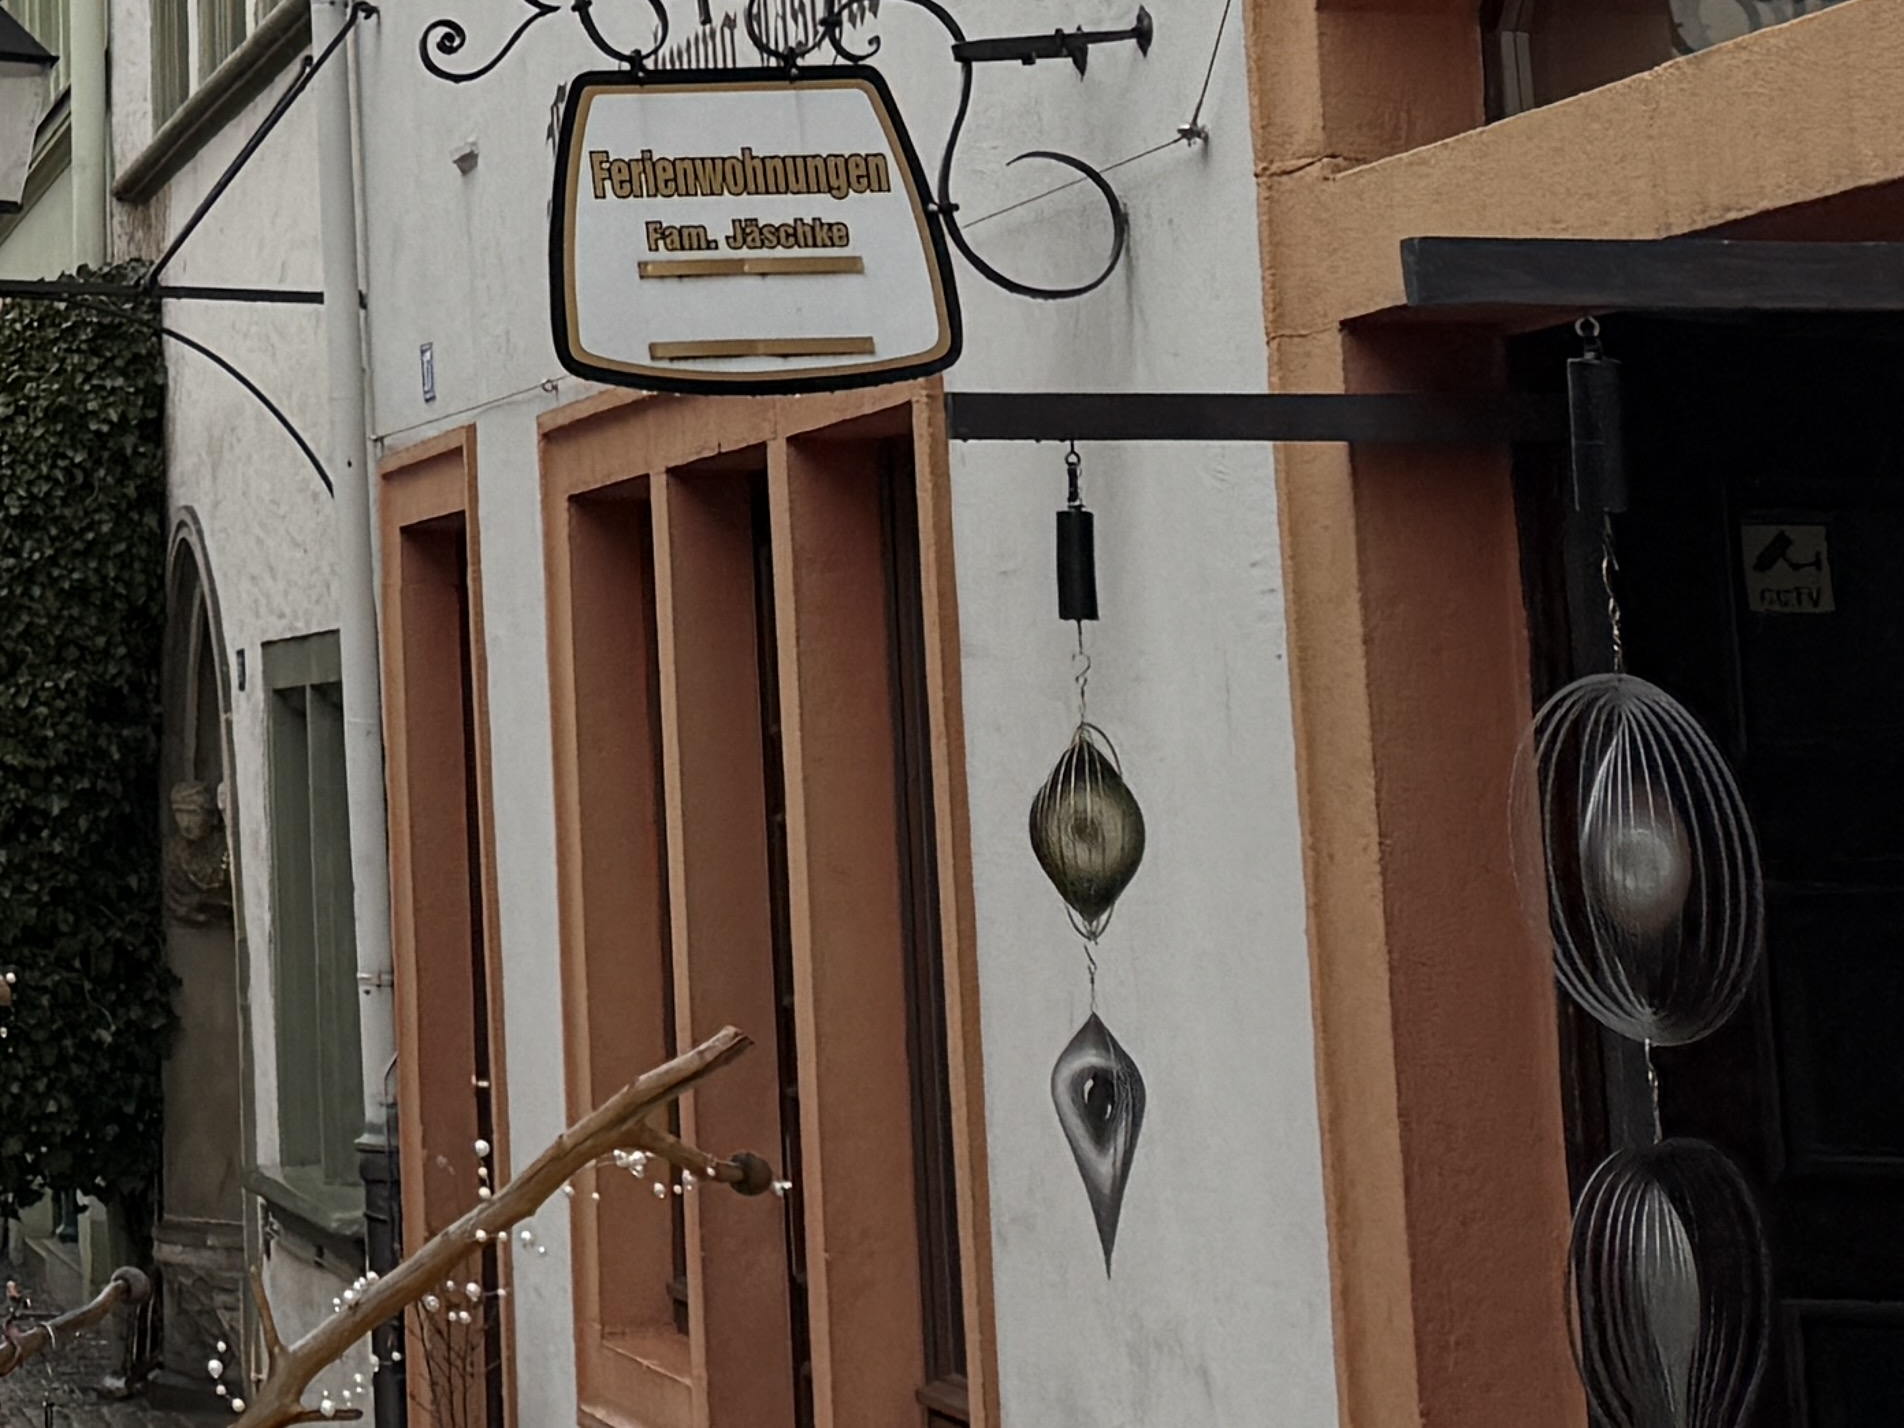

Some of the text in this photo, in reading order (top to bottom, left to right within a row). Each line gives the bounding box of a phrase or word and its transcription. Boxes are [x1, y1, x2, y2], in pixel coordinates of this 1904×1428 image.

[588, 147, 892, 201] Ferienwohnungen
[644, 216, 850, 253] Fam. Jäschke
